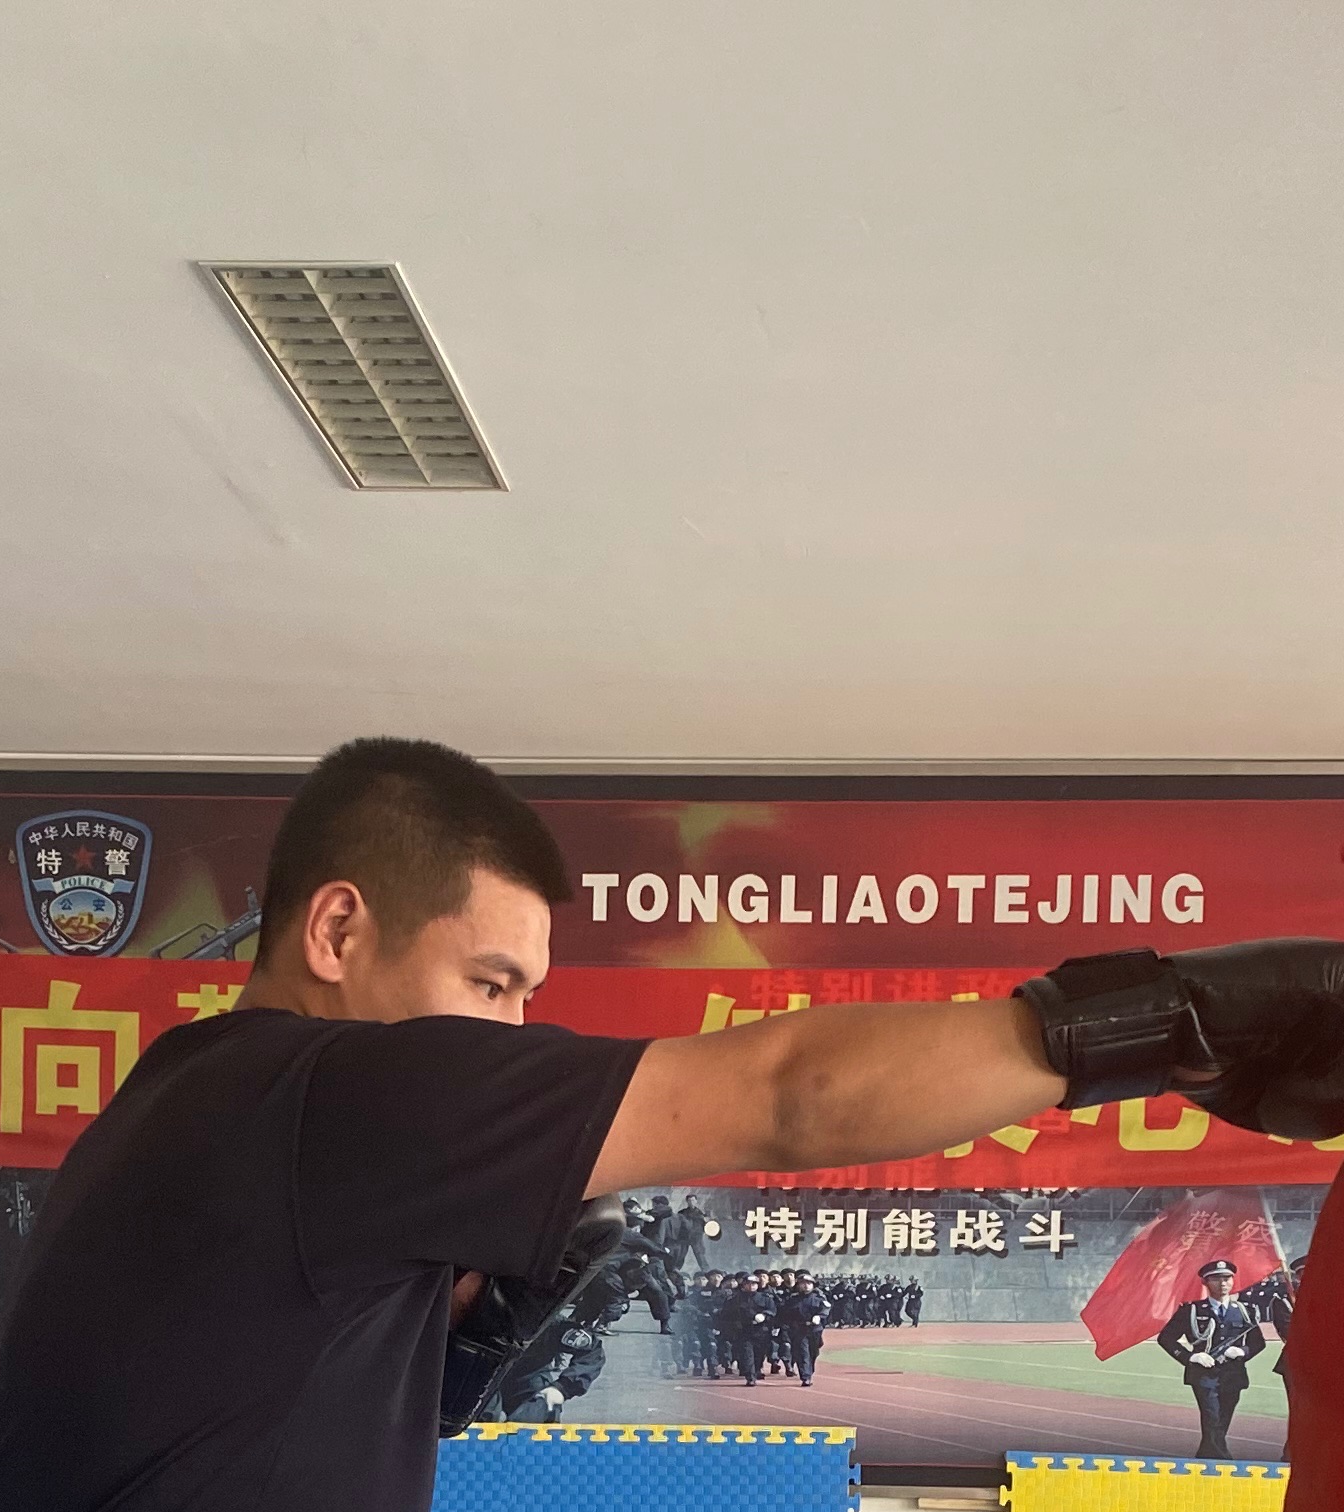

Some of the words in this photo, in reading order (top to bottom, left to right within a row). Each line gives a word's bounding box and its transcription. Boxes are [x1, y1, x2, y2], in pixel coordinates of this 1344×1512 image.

[29, 822, 138, 850] 中华人民共和国
[36, 848, 130, 875] 特警
[60, 877, 108, 890] POLICE
[59, 898, 106, 912] 公安
[582, 872, 1206, 925] TONGLIAOTEJING
[744, 1206, 1076, 1254] 特别能战斗
